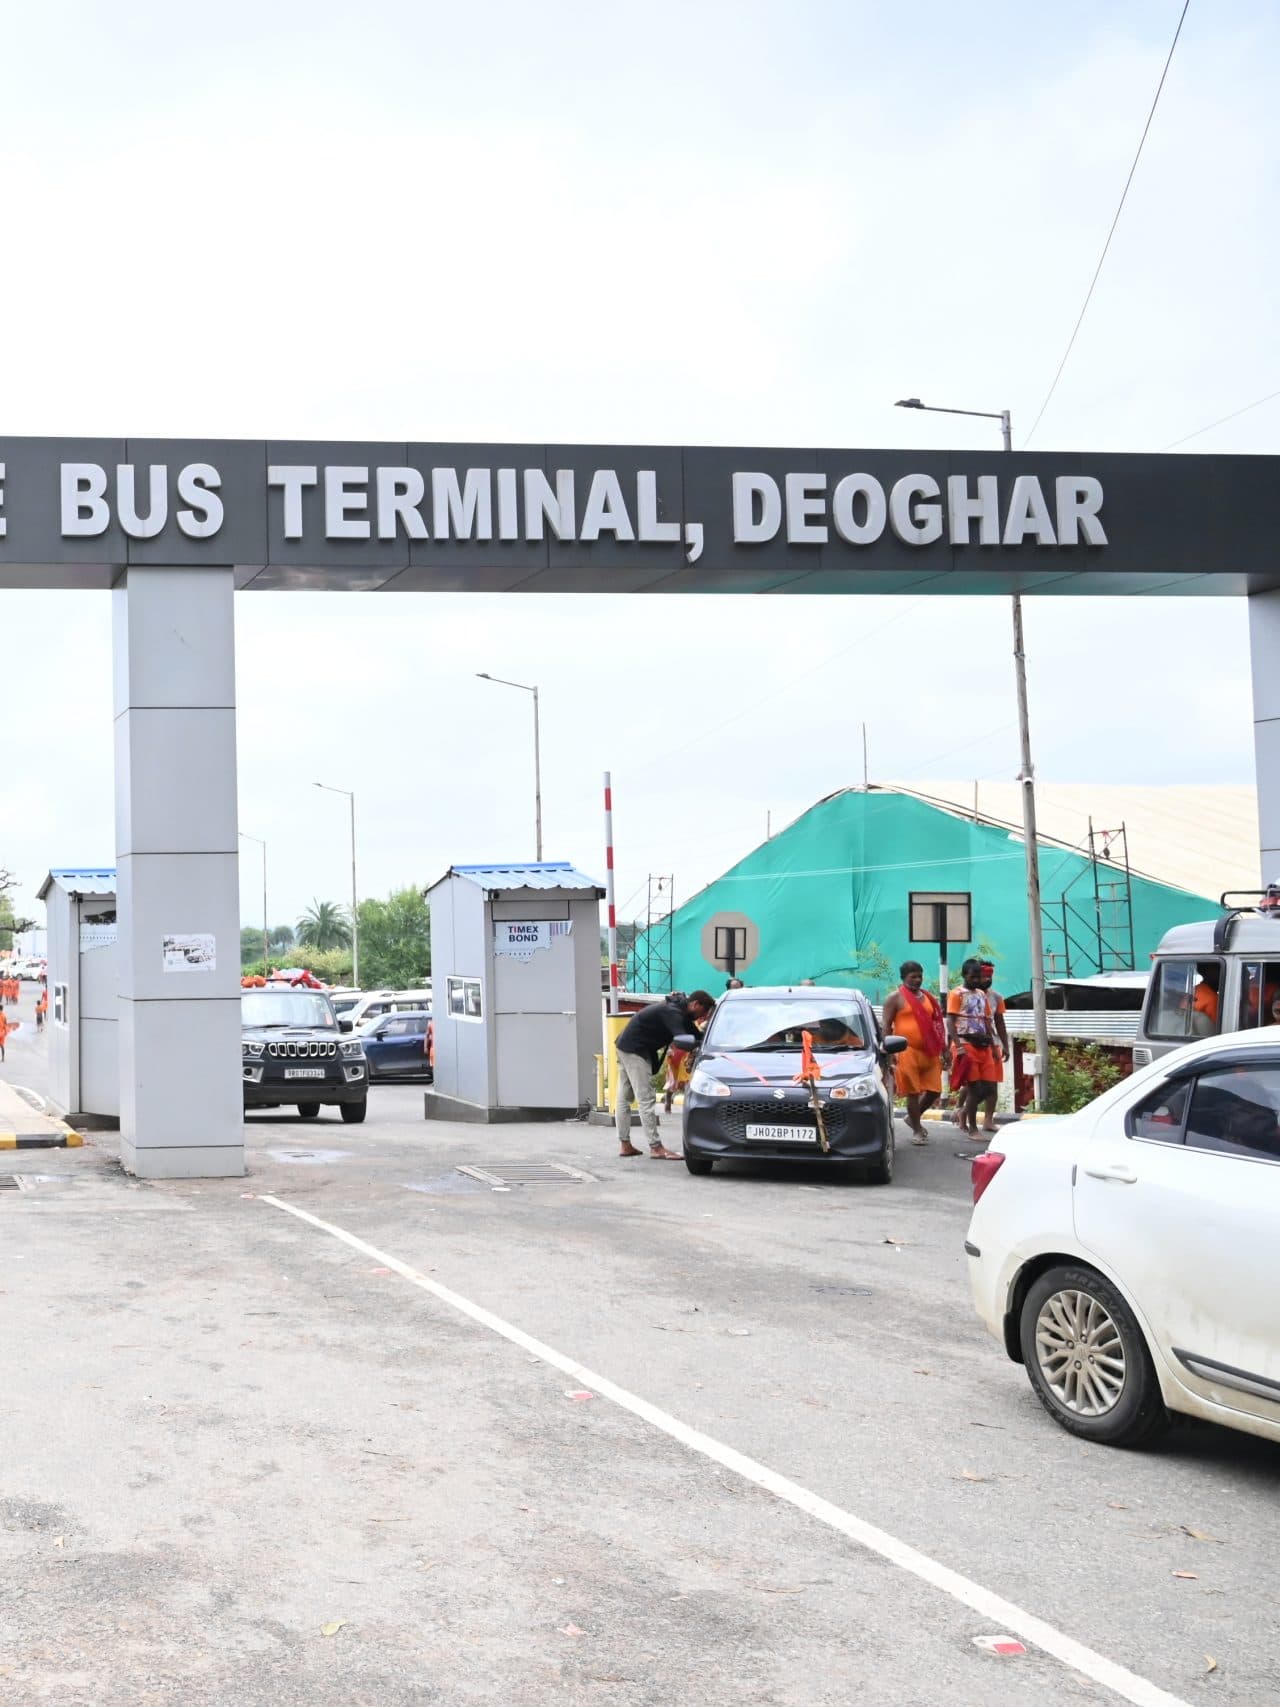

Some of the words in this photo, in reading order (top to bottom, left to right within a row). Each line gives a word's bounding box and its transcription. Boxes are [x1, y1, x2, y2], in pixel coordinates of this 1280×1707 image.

[60, 461, 224, 539] BUS
[267, 464, 705, 563] TERMINAL,
[732, 470, 1109, 547] DEOGHAR
[507, 925, 539, 934] TIMEX
[508, 934, 539, 943] BOND
[752, 1127, 815, 1140] JH02BP1172
